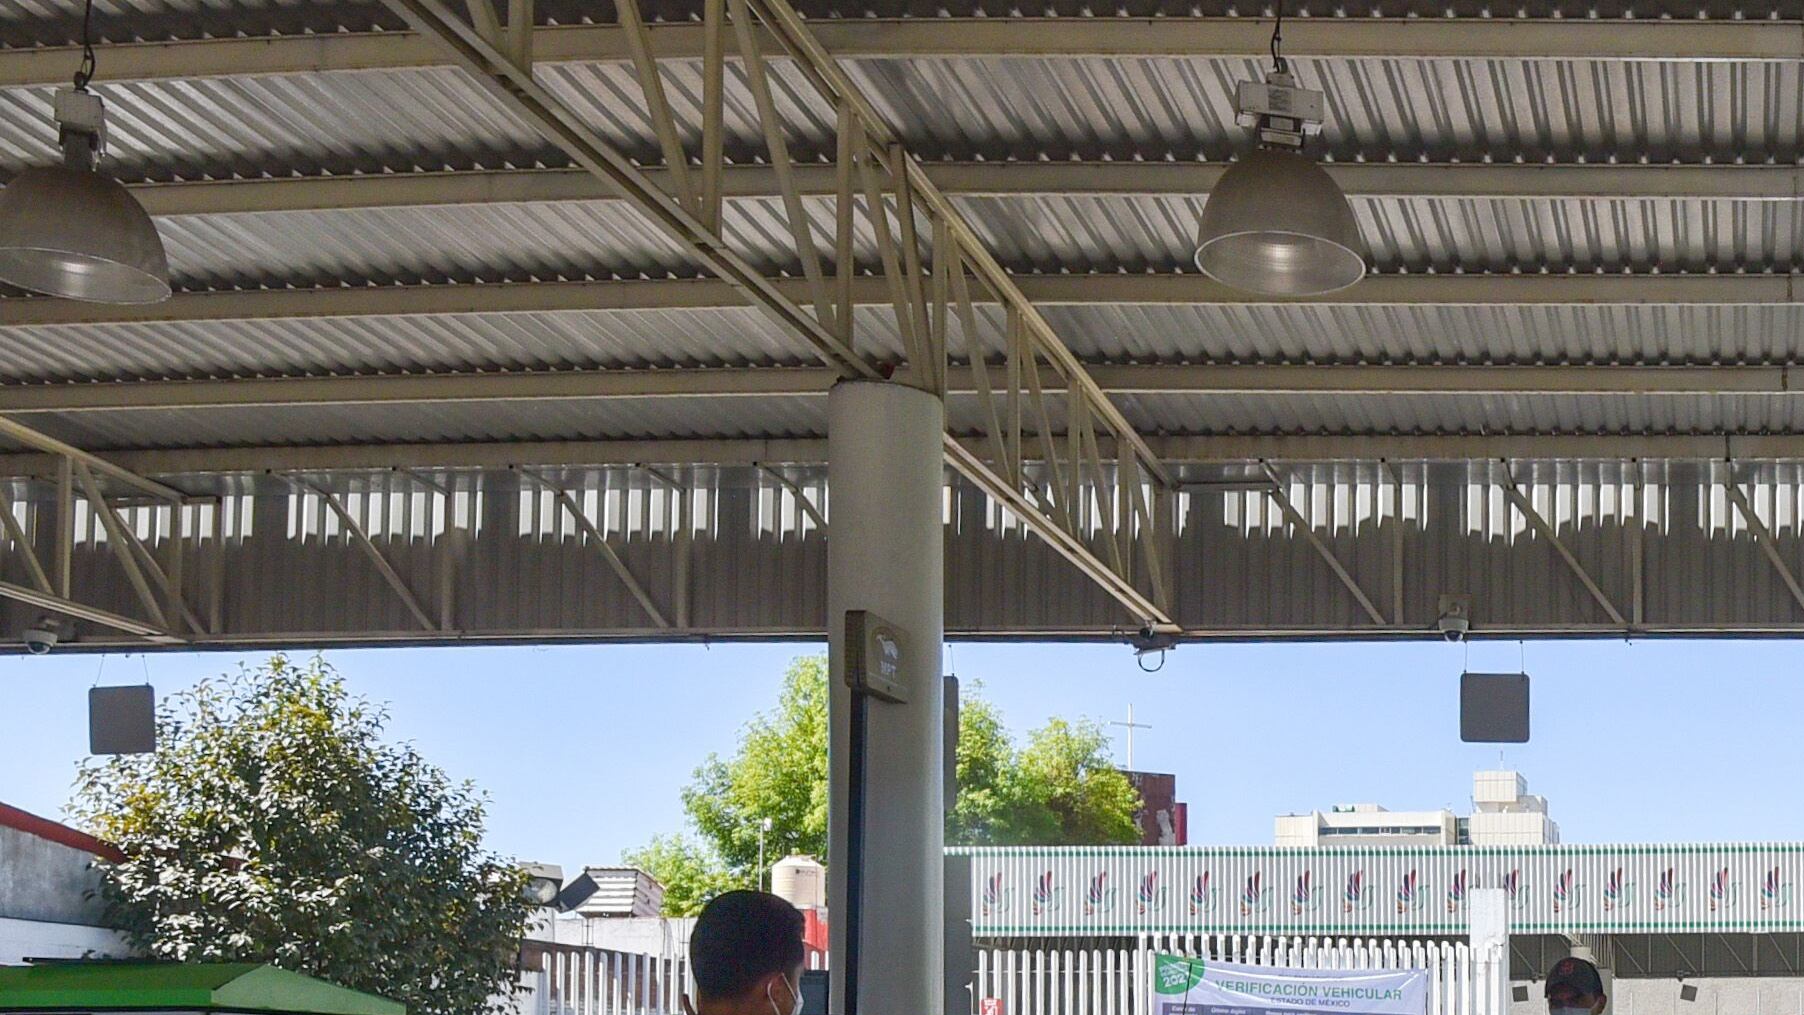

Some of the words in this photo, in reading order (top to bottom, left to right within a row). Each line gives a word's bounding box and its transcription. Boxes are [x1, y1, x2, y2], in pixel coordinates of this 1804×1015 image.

[1163, 973, 1191, 988] 202
[1215, 980, 1318, 998] VERIFICACIÓN
[1322, 984, 1402, 1001] VEHICULAR
[1305, 997, 1317, 1006] DE
[1318, 997, 1351, 1008] MÉXICO
